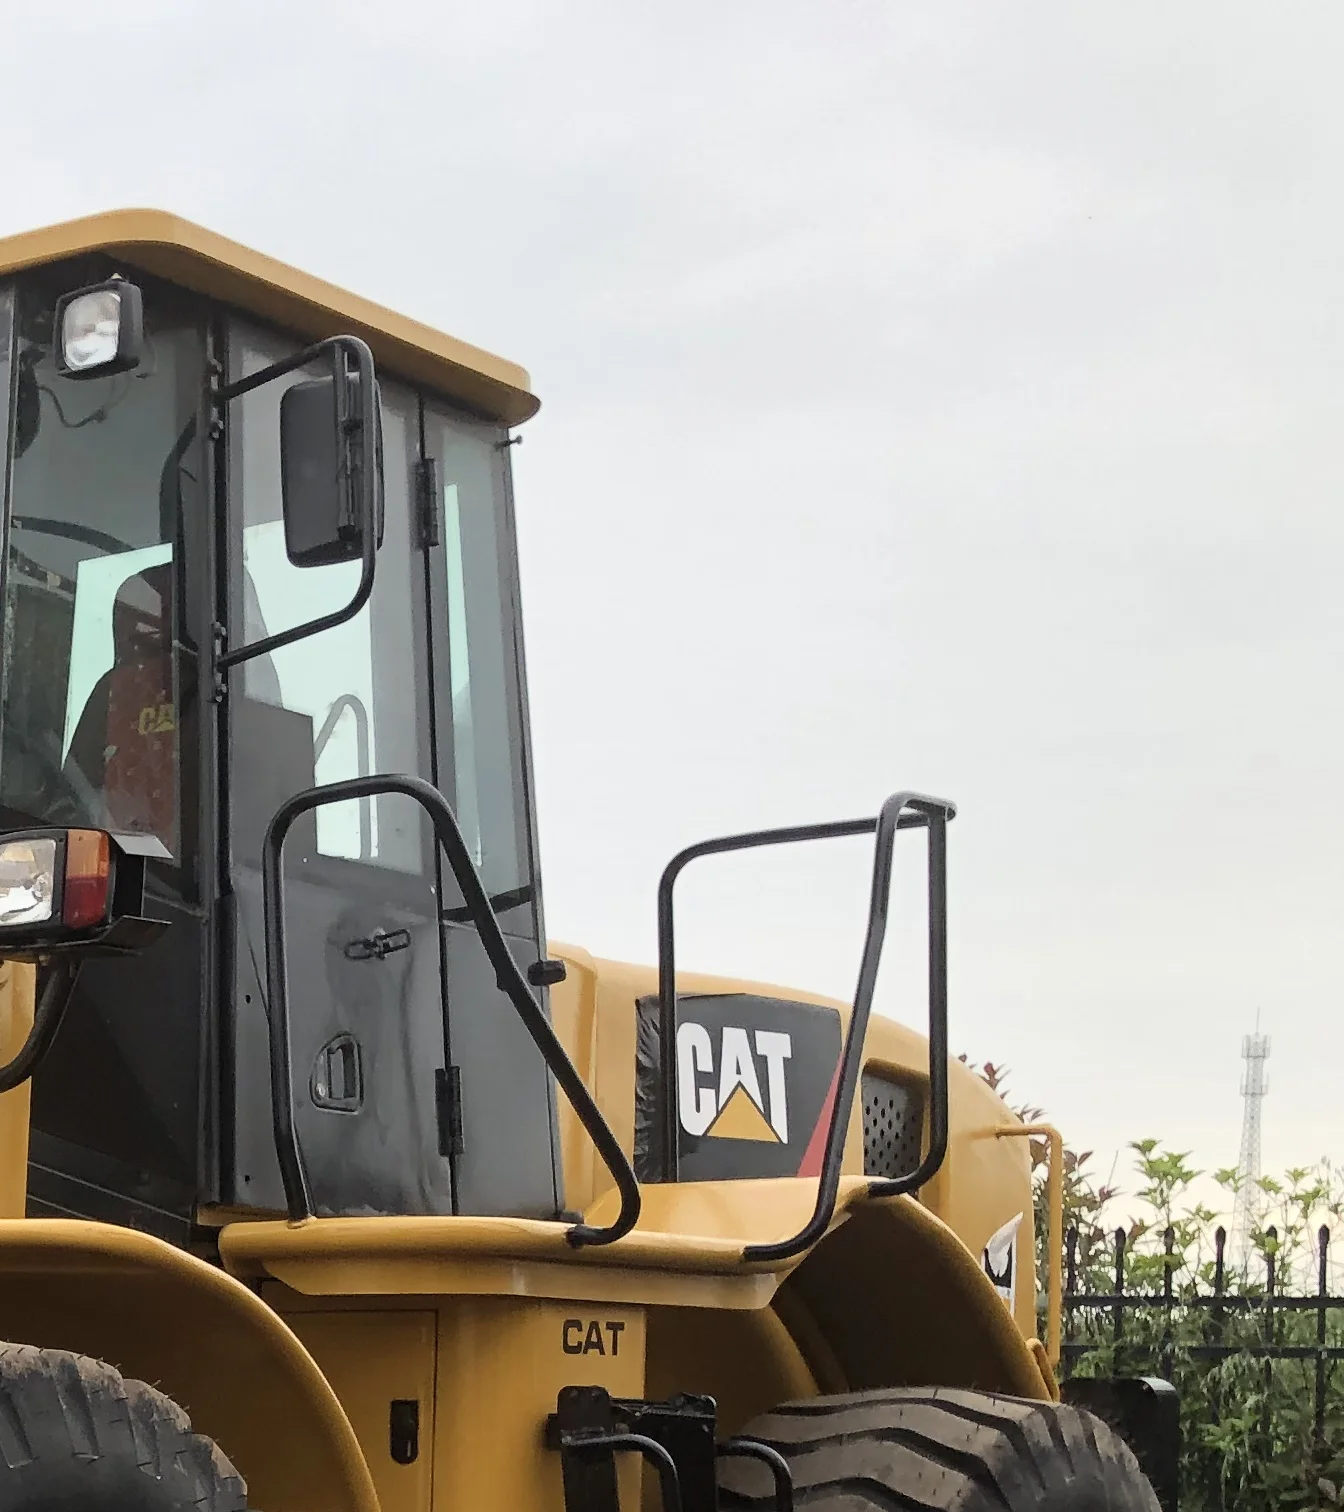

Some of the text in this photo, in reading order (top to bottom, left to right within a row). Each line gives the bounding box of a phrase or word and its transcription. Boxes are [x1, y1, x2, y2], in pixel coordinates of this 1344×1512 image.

[138, 704, 175, 736] CA
[676, 1022, 792, 1145] CAT
[562, 1318, 626, 1357] CAT
